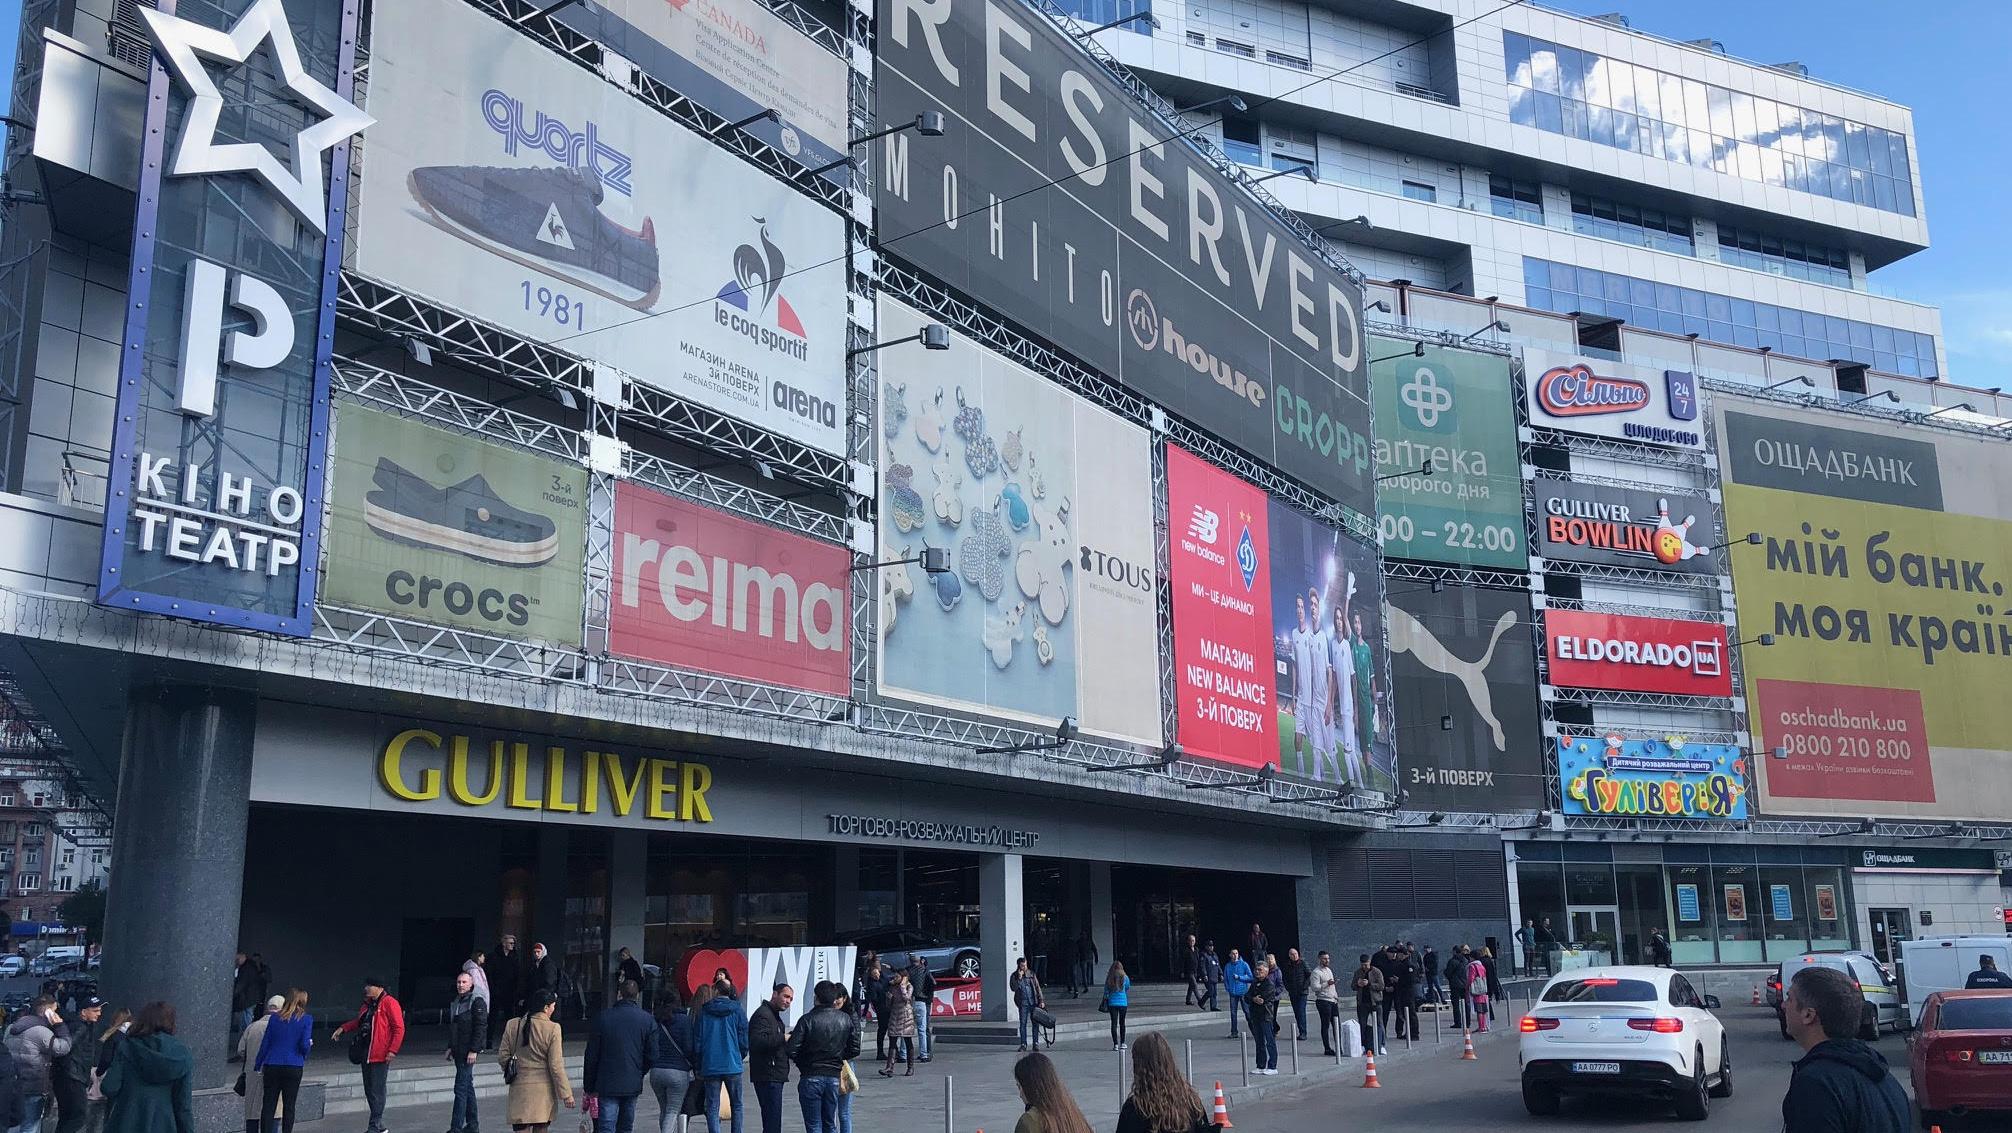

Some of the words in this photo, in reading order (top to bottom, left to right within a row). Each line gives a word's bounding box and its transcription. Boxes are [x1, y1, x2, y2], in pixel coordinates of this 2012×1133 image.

[482, 89, 632, 198] quartz
[886, 123, 1113, 327] MOHITO
[520, 280, 585, 332] 1981
[714, 301, 728, 326] le
[731, 314, 759, 345] coq
[761, 327, 808, 362] sportif
[680, 340, 726, 370] МАГАЗИН
[728, 361, 760, 383] ARENA
[1162, 317, 1266, 408] house
[683, 371, 760, 409] ARENASTORE.COM.UA
[722, 372, 760, 397] ПОВЕРХ
[1549, 371, 1647, 408] Сільпо
[1674, 382, 1689, 398] 24
[773, 380, 836, 430] arena
[1680, 400, 1688, 414] 7
[1276, 384, 1369, 476] CROPP
[1375, 438, 1488, 477] аптека
[1754, 438, 1918, 487] ОЩАДБАНК
[136, 453, 304, 525] КІНО
[542, 491, 579, 509] поверх
[551, 475, 571, 495] 3-й
[1377, 472, 1452, 495] доброго
[1457, 483, 1490, 501] дня
[1546, 497, 1632, 523] GULLIVER
[134, 509, 300, 577] ТЕАТР
[1181, 539, 1196, 553] new
[1196, 543, 1225, 566] balance
[1444, 521, 1516, 553] 22:00
[1093, 550, 1151, 592] TOUS
[1767, 521, 1849, 579] мій
[1866, 530, 2003, 597] банк.
[386, 570, 529, 626] crocs
[621, 532, 844, 652] reima
[1191, 582, 1204, 597] МИ
[1210, 589, 1220, 604] ЦЕ
[1774, 602, 1871, 644] моя
[1200, 638, 1254, 673] МАГАЗИН
[1555, 635, 1692, 668] ELDORADO
[1697, 651, 1715, 664] UA
[1187, 664, 1213, 690] NEW
[1215, 673, 1266, 705] BALANCE
[1197, 696, 1218, 722] 3-Й
[1220, 704, 1263, 733] ПОВЕРХ
[1781, 706, 1907, 732] oschadbank.ua
[1782, 733, 1832, 756] 0800
[1837, 736, 1870, 758] 210
[1876, 739, 1911, 760] 800
[380, 729, 713, 822] GULLIVER
[1410, 767, 1436, 784] 3-й
[1439, 769, 1494, 787] ПОВЕРХ
[828, 813, 1003, 845] ТОРГОВО-РОЗВАЖАЛЬНИЙ
[1004, 829, 1040, 850] ЦЕНТР
[1577, 1063, 1588, 1071] AA
[2000, 1053, 2012, 1061] 71
